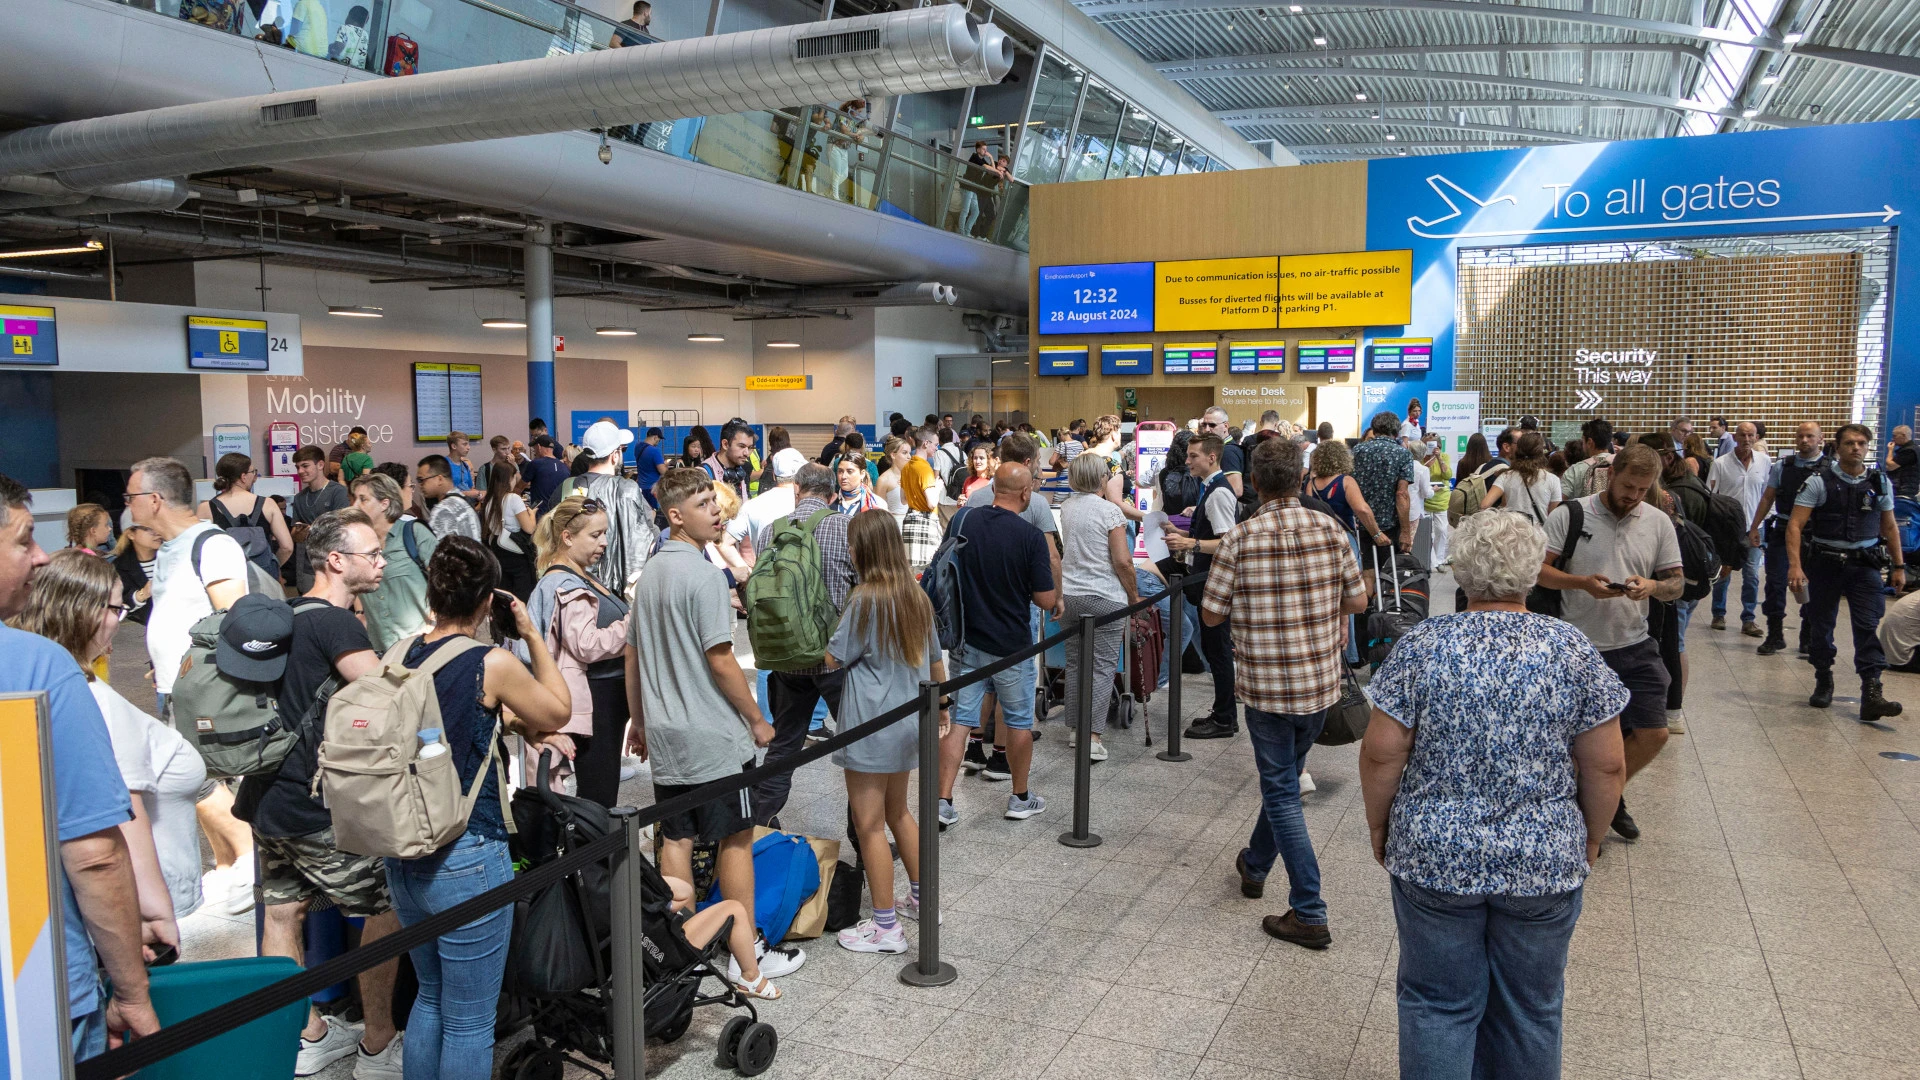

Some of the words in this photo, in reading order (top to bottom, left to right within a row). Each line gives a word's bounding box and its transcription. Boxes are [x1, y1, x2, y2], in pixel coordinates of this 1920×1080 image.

[1542, 183, 1590, 219] To
[1605, 178, 1645, 216] all
[1661, 175, 1780, 221] gates
[1165, 275, 1182, 283] Due
[1196, 272, 1264, 282] communication
[1266, 271, 1297, 279] issues,
[1314, 267, 1359, 277] air-traffic
[1361, 265, 1400, 277] possible
[1073, 288, 1118, 304] 12:32
[1179, 297, 1207, 305] Busses
[1224, 294, 1261, 303] diverted
[1264, 294, 1295, 303] flights
[1297, 292, 1313, 301] will
[1316, 292, 1328, 300] be
[1330, 290, 1372, 299] available
[1374, 290, 1384, 298] at
[1051, 311, 1065, 322] 28
[1067, 310, 1107, 324] August
[1110, 309, 1138, 320] 2024
[1221, 306, 1259, 314] Platform
[1285, 304, 1320, 314] parking
[271, 337, 288, 352] 24
[1575, 348, 1657, 368] Security
[1574, 367, 1611, 384] This
[1615, 370, 1653, 385] way
[1222, 387, 1257, 396] Service
[1261, 387, 1286, 396] Desk
[1364, 386, 1387, 395] Fast
[267, 387, 366, 420] Mobility
[1273, 398, 1288, 406] help
[1289, 398, 1303, 406] you
[1442, 402, 1475, 410] transavia
